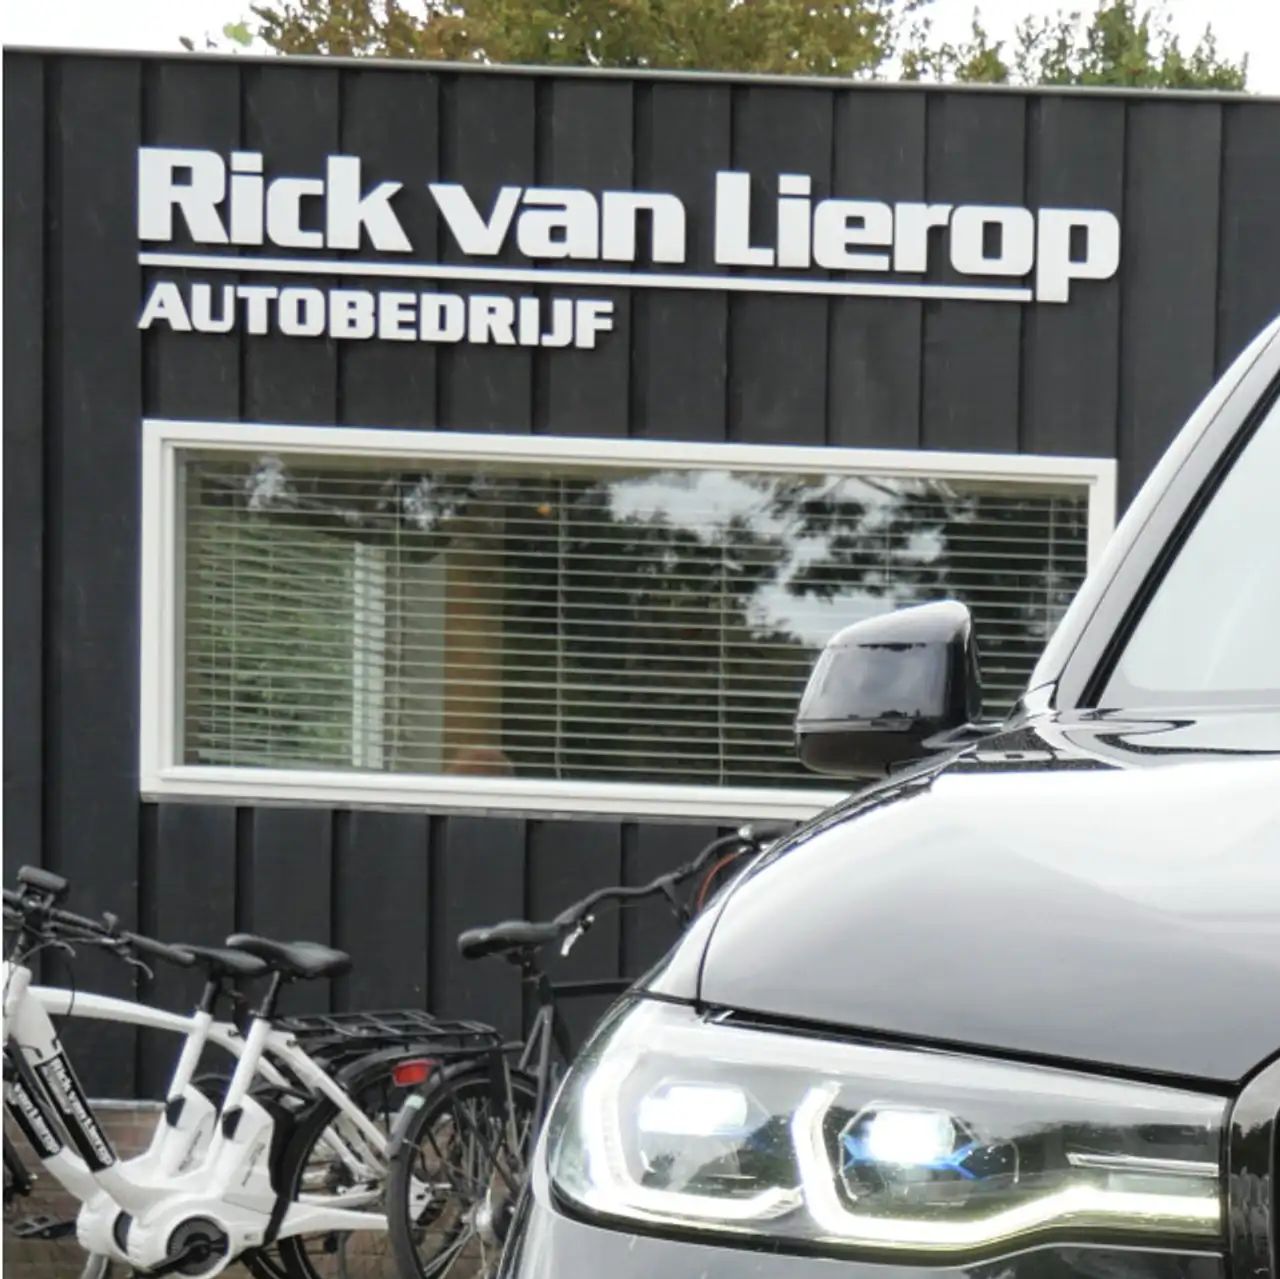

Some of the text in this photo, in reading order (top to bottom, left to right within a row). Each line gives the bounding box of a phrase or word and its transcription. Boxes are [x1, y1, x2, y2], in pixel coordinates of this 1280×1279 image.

[138, 148, 1120, 302] Rick van Lierop
[138, 282, 613, 348] AUTOBEDRIJF
